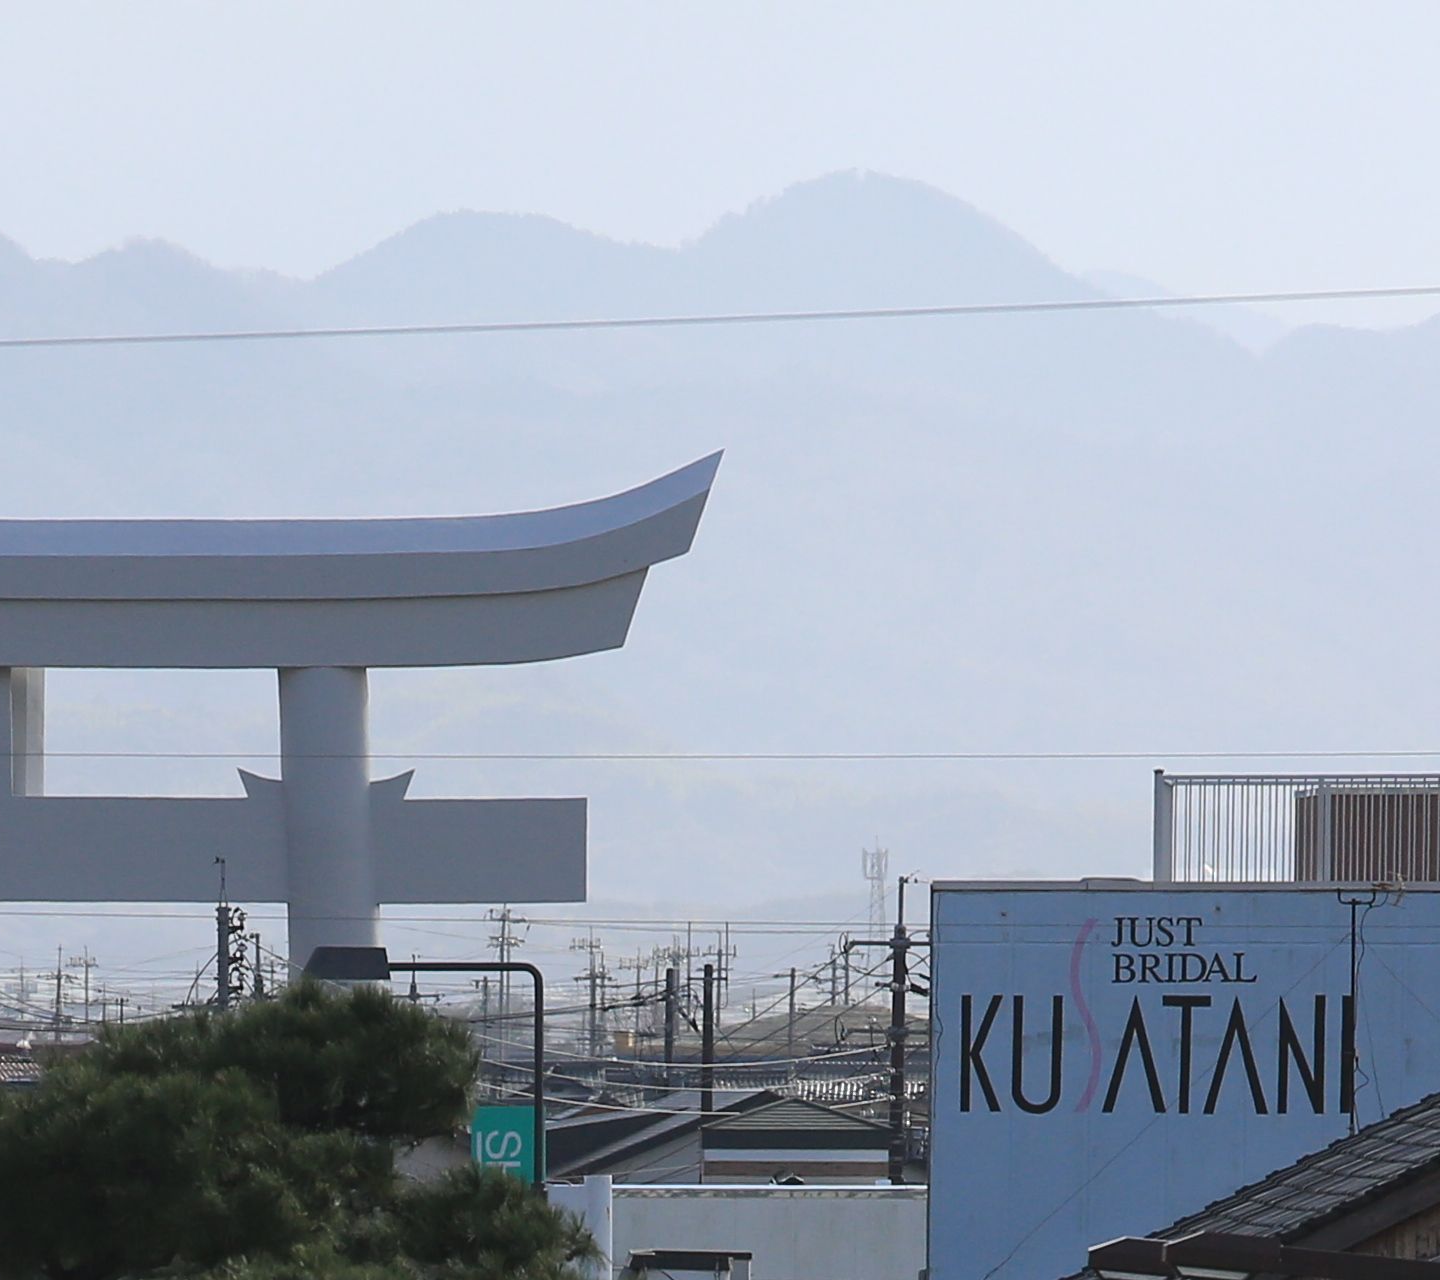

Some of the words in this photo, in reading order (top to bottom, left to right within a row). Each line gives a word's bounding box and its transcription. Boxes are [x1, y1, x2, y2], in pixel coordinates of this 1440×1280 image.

[1110, 916, 1202, 948] JUST
[1112, 952, 1257, 983] BRIDAL
[959, 918, 1355, 1114] KUSATANI
